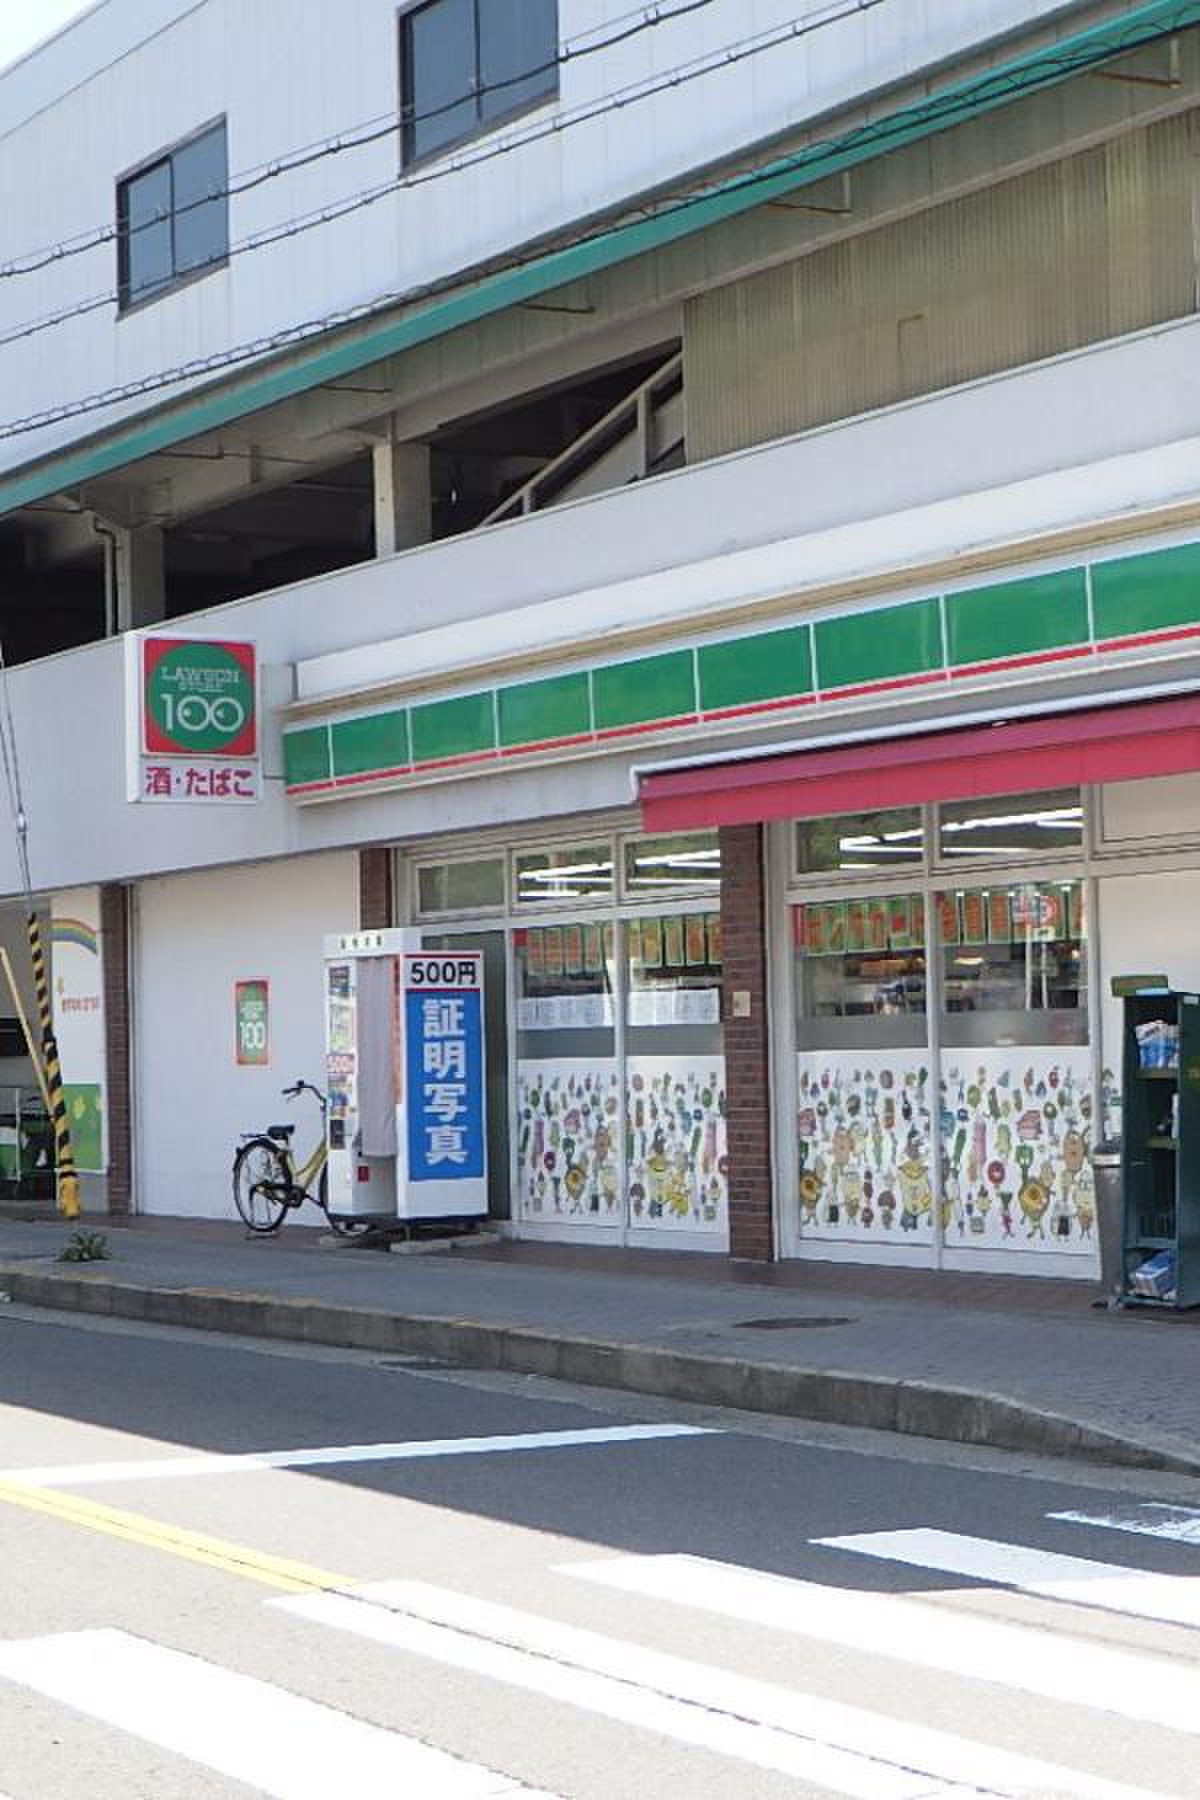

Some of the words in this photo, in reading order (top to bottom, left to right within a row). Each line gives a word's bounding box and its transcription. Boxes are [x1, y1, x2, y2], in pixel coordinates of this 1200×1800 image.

[160, 693, 245, 732] 100
[411, 961, 476, 985] 500円
[239, 1021, 265, 1050] 100
[422, 998, 468, 1166] 証明写真
